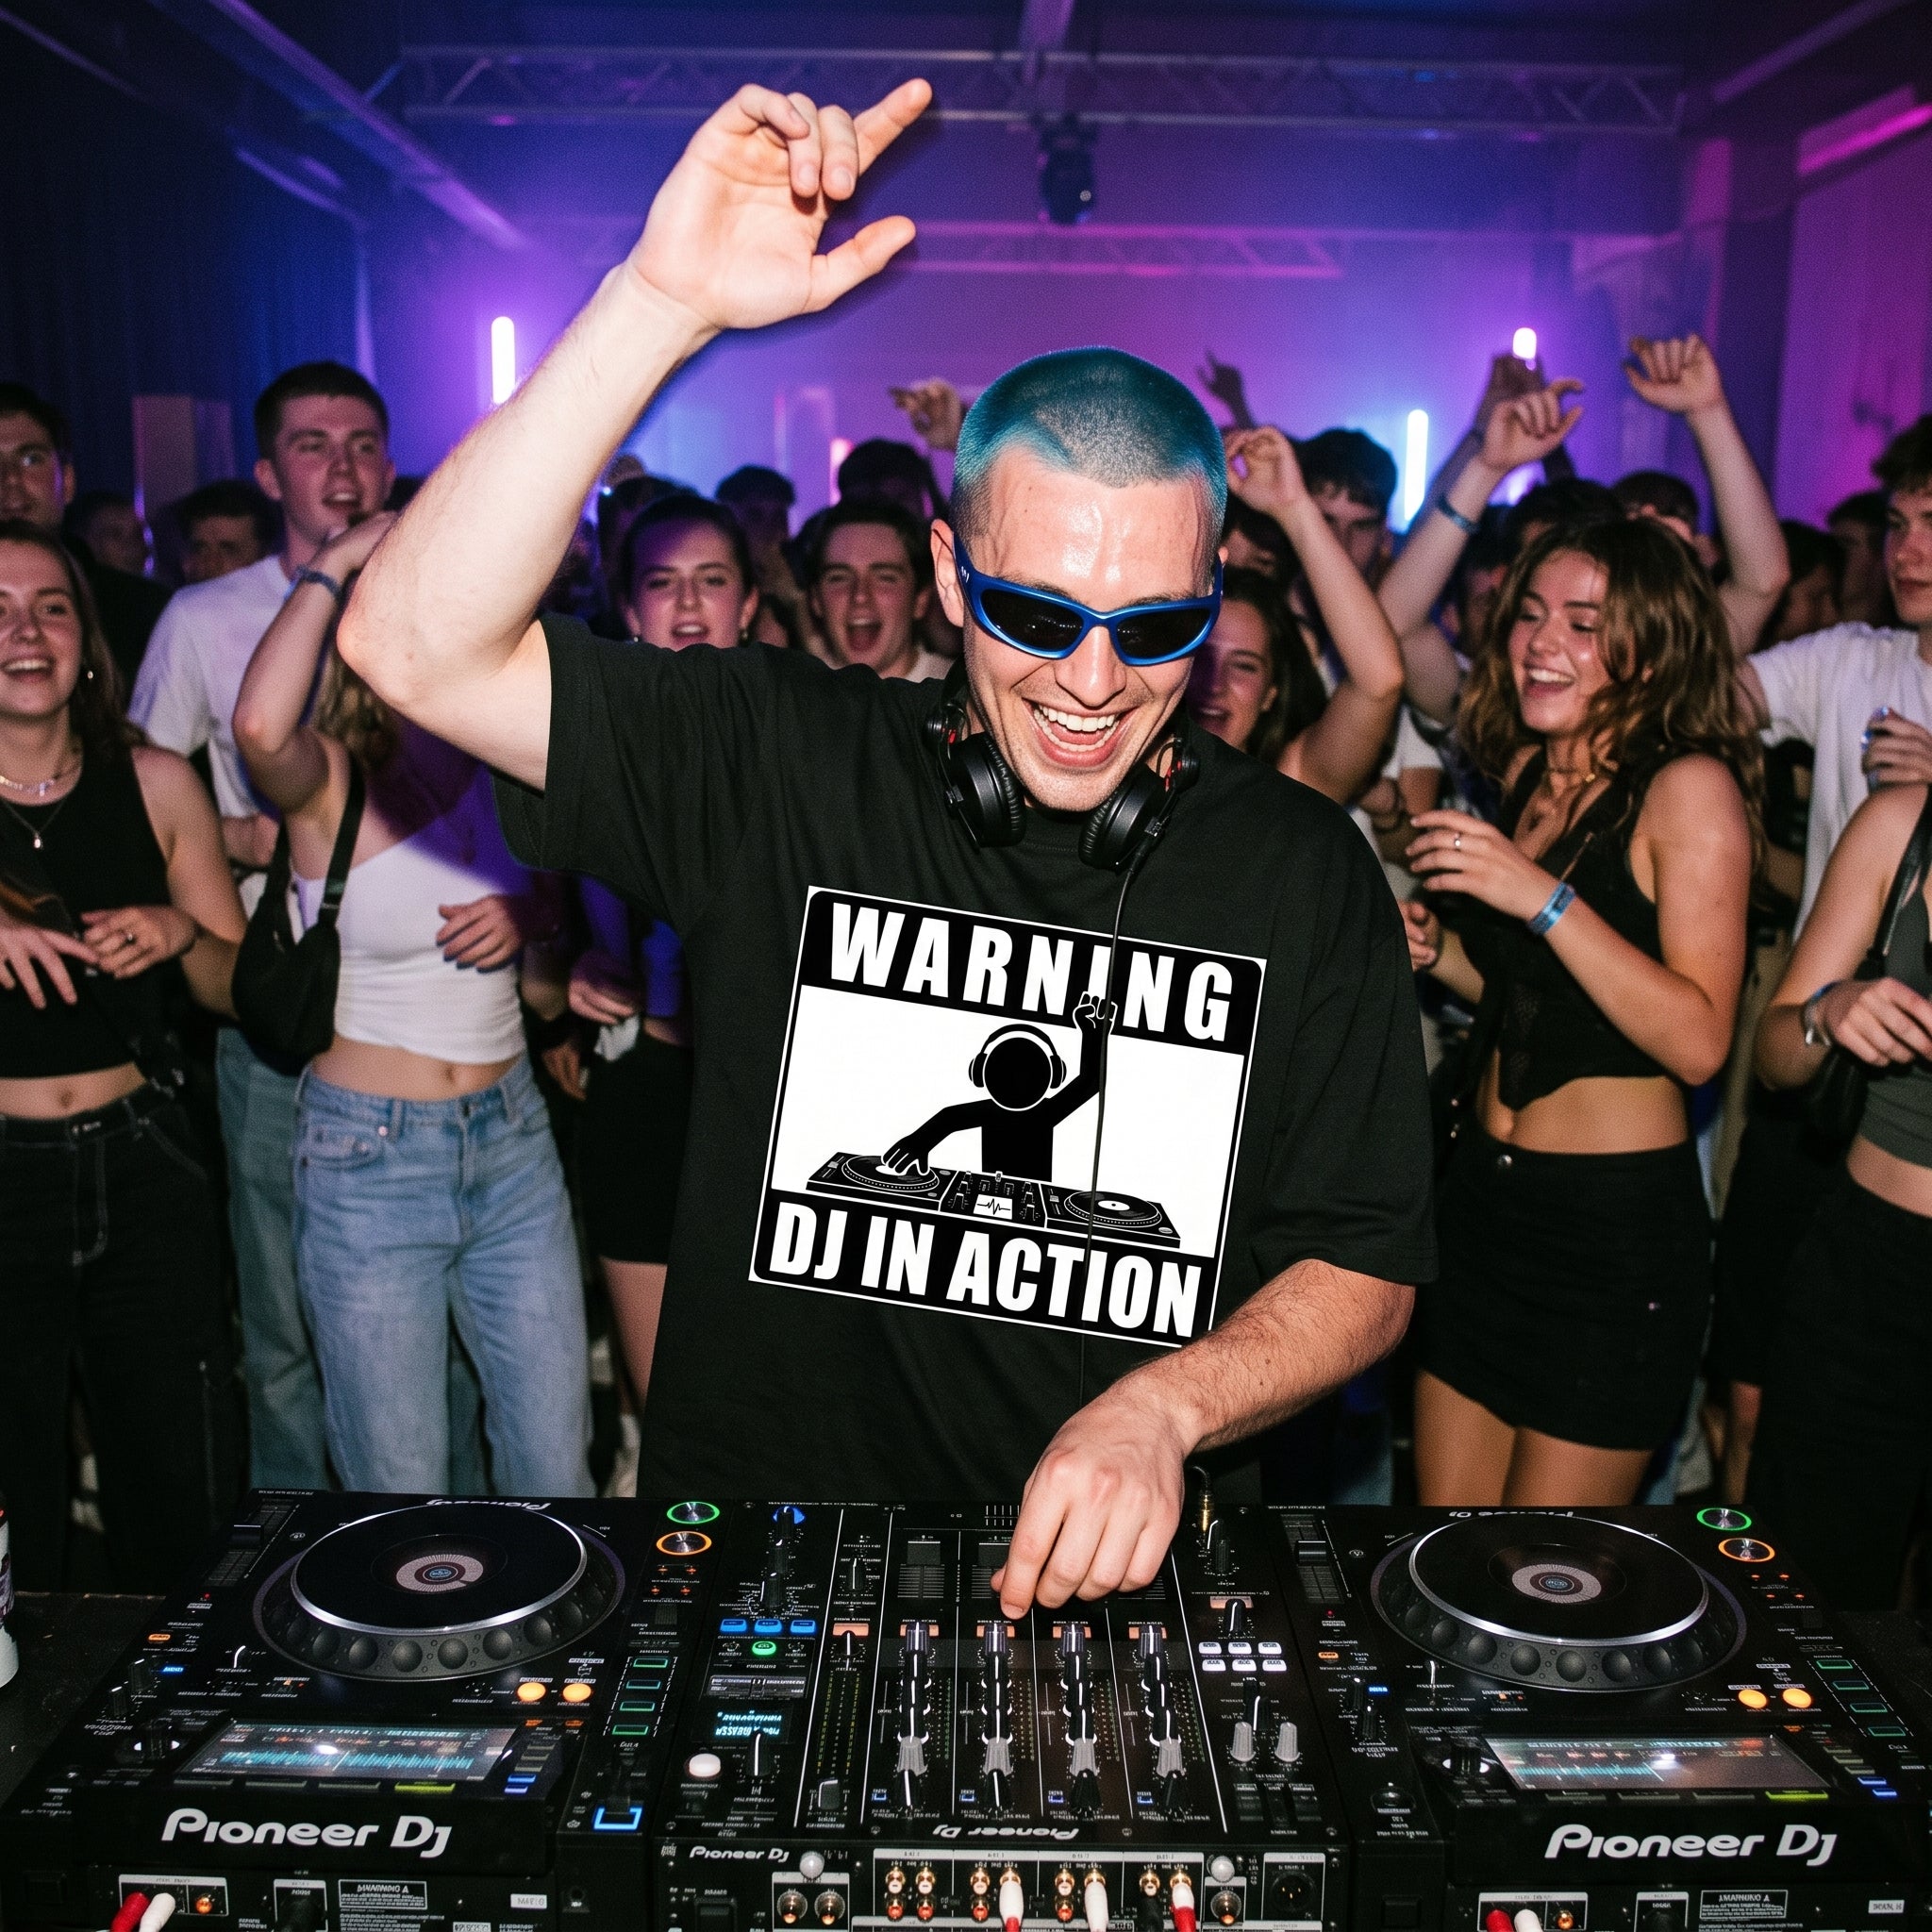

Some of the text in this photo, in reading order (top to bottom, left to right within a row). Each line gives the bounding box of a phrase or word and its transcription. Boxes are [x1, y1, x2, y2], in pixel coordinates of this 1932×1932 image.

[830, 902, 1232, 1041] WARNING
[769, 1202, 1202, 1338] DJ IN ACTION
[161, 1807, 379, 1846] Pioneer
[1544, 1824, 1765, 1858] Pioneer
[690, 1845, 765, 1860] Pioneer
